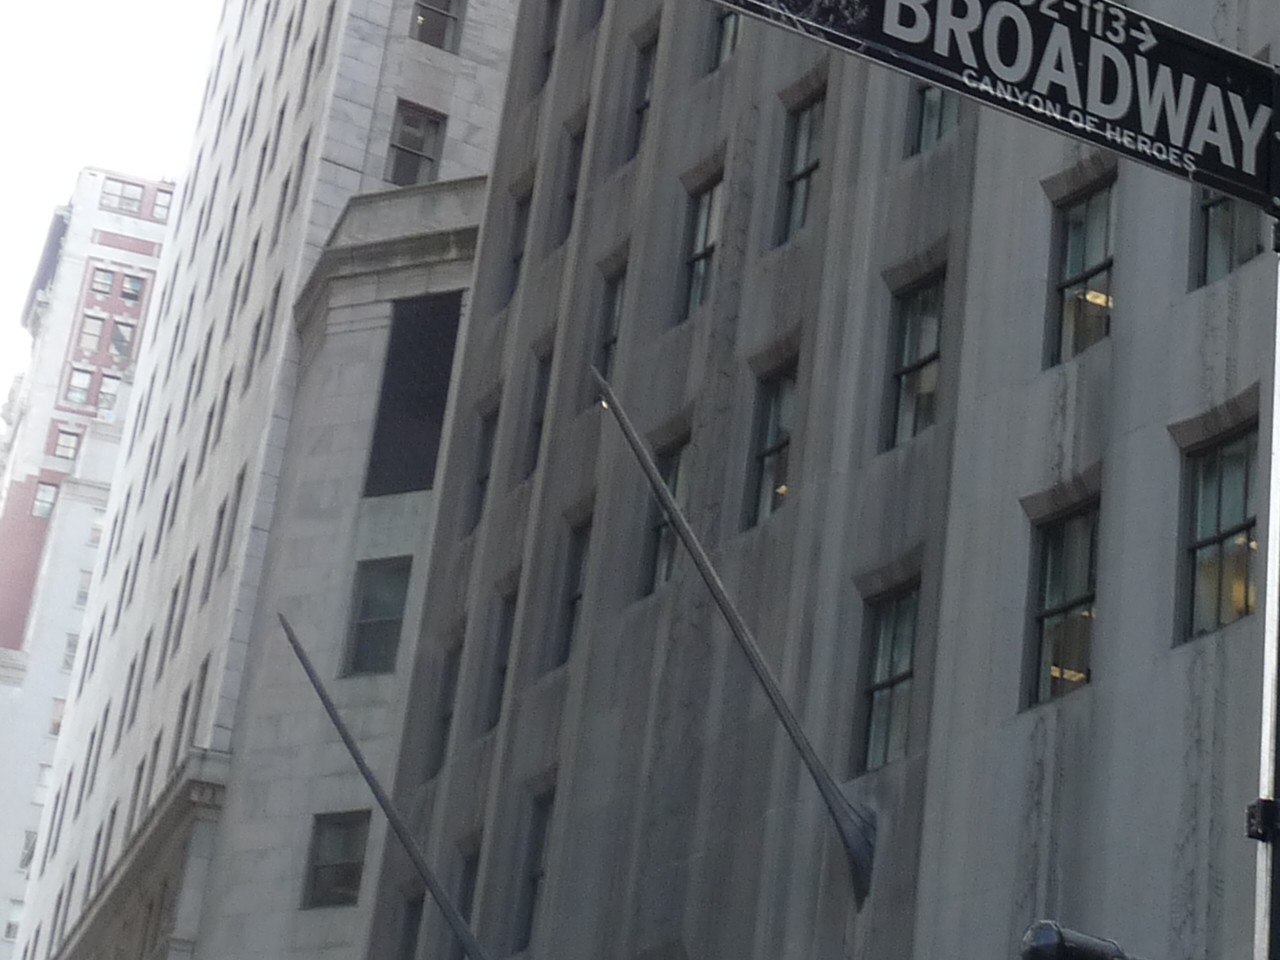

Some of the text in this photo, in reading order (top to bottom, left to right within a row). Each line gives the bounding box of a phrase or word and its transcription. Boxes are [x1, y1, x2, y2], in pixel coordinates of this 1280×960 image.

[961, 68, 1197, 172] CANYON OF HEROES
